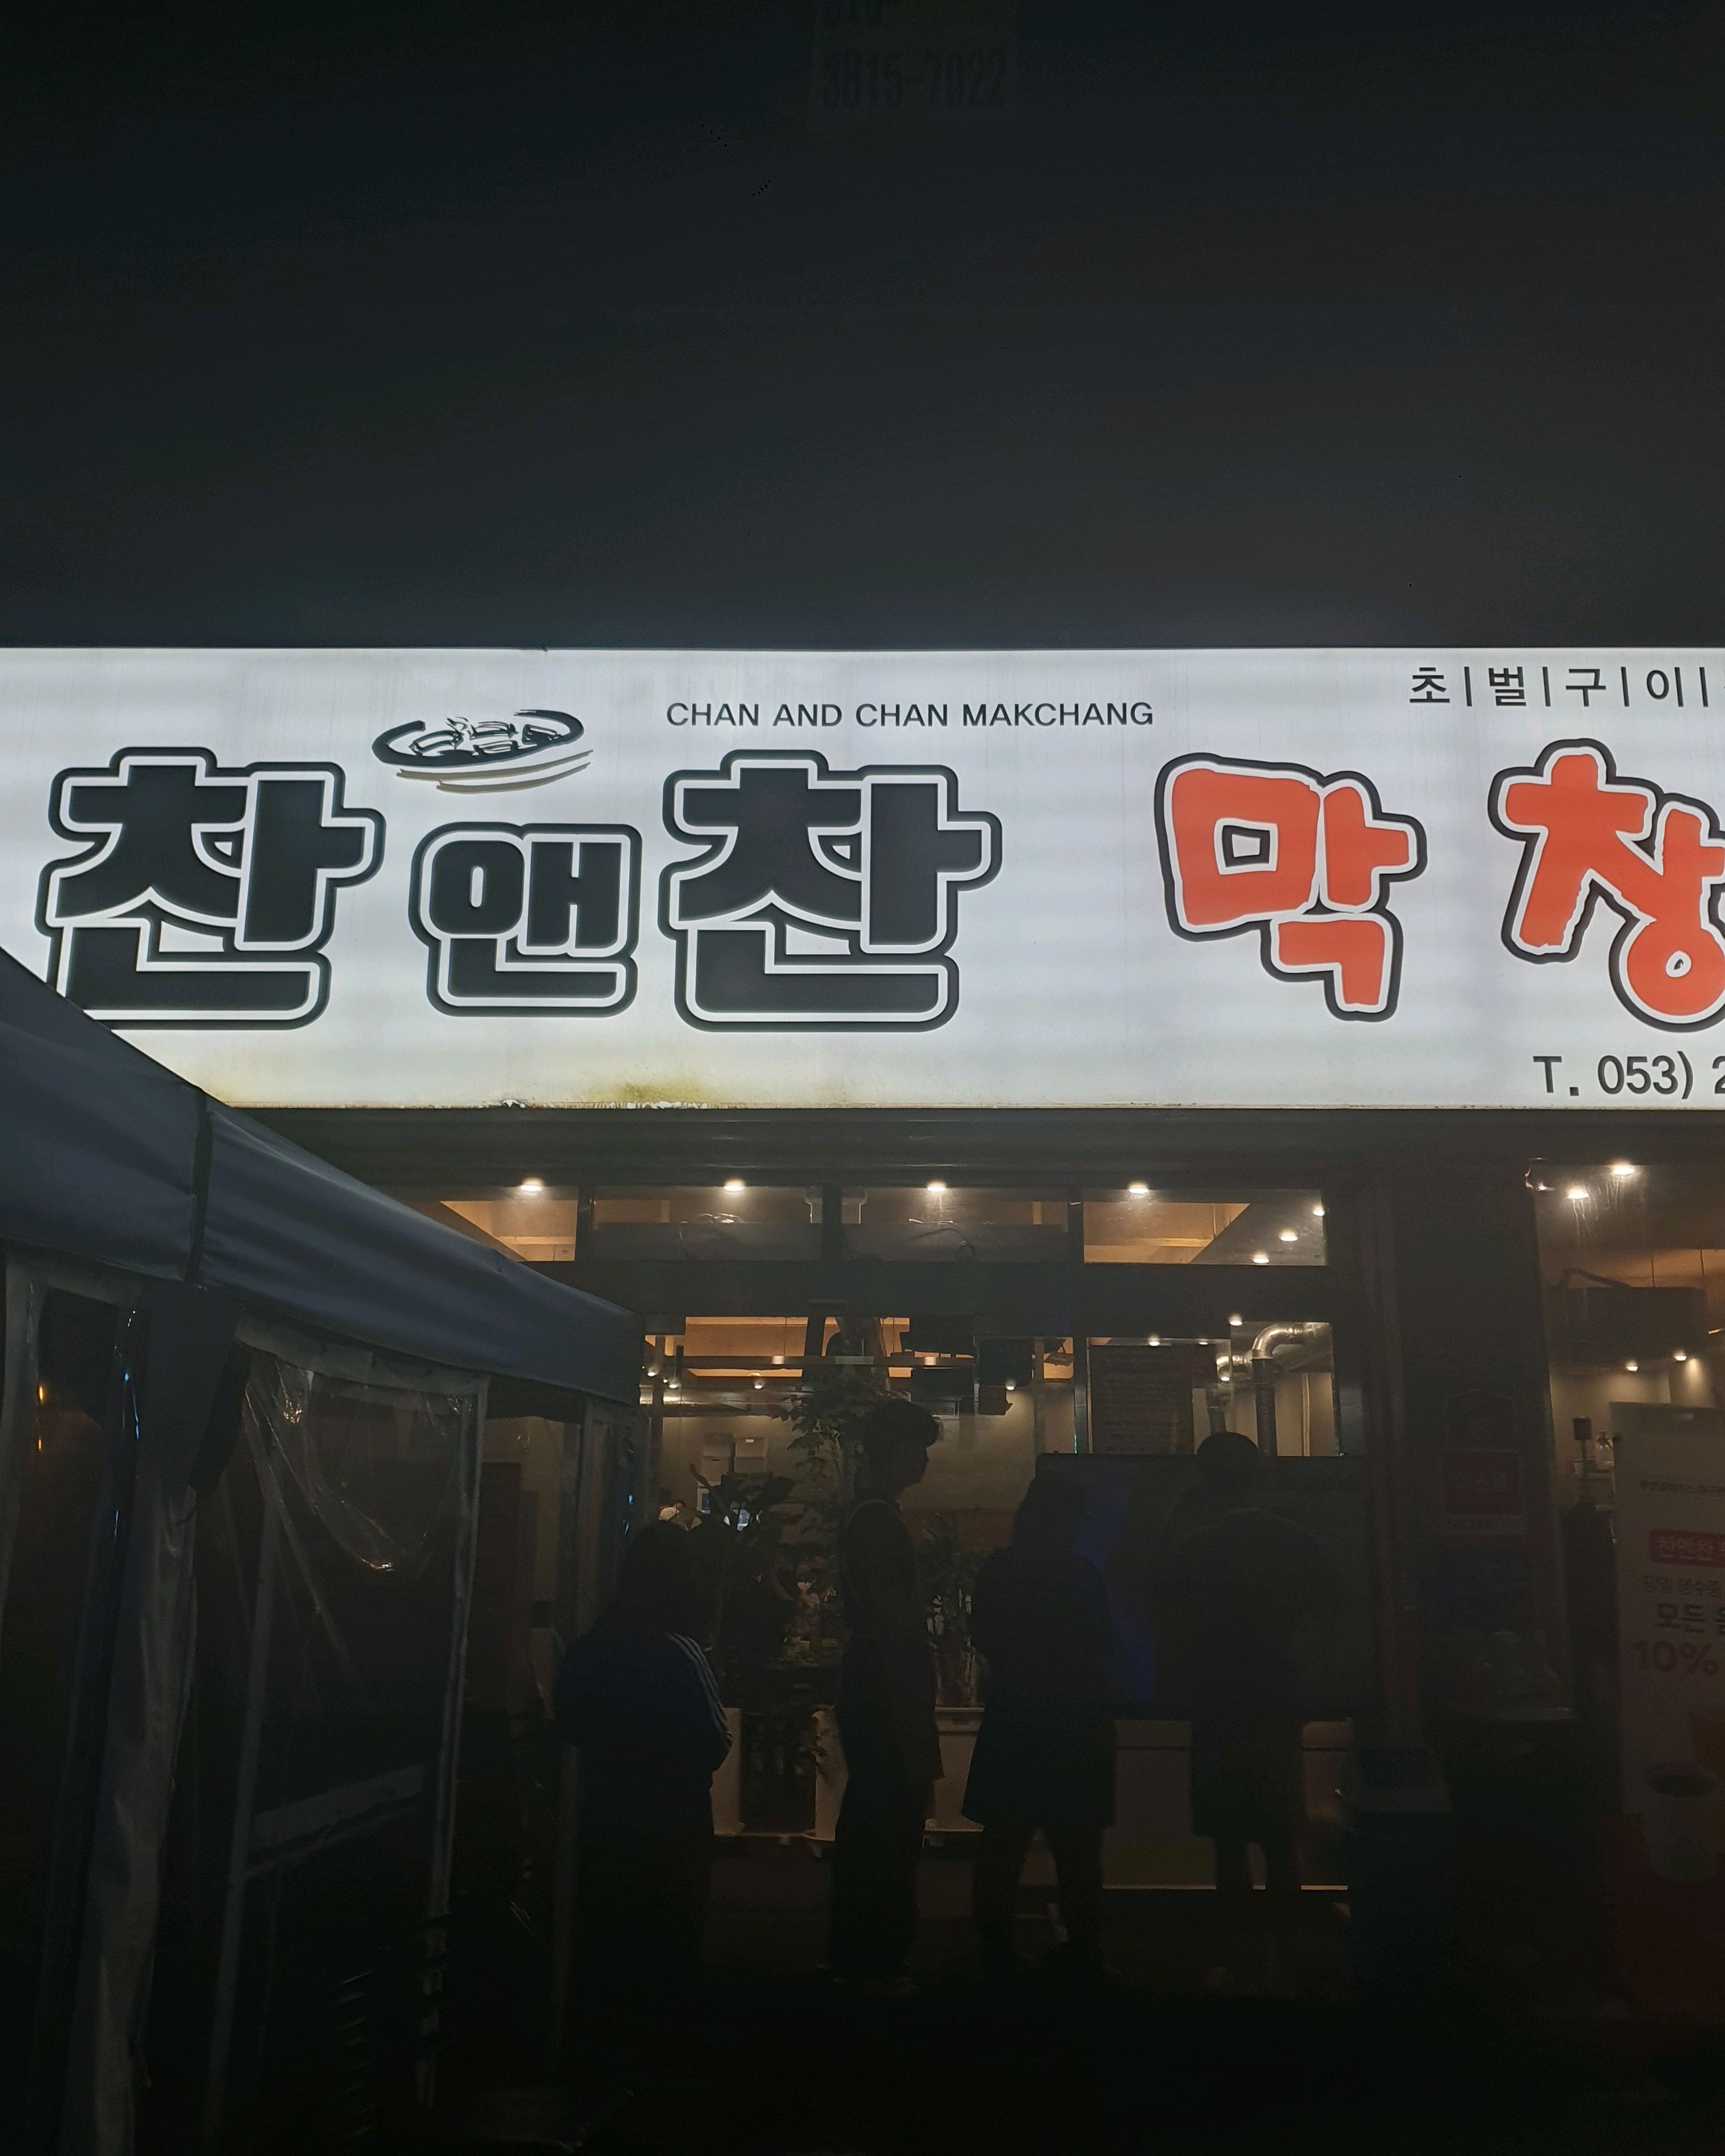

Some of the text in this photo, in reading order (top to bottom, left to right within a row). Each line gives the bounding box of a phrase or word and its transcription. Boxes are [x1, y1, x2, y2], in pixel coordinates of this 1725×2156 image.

[666, 702, 1153, 727] CHAN AND CHAN MAKCHANG
[35, 747, 1002, 1032] 찬앤찬
[1532, 1055, 1580, 1096] T.
[1597, 1050, 1694, 1100] 053)
[1654, 1603, 1706, 1634] 모든
[1633, 1639, 1720, 1676] 10%
